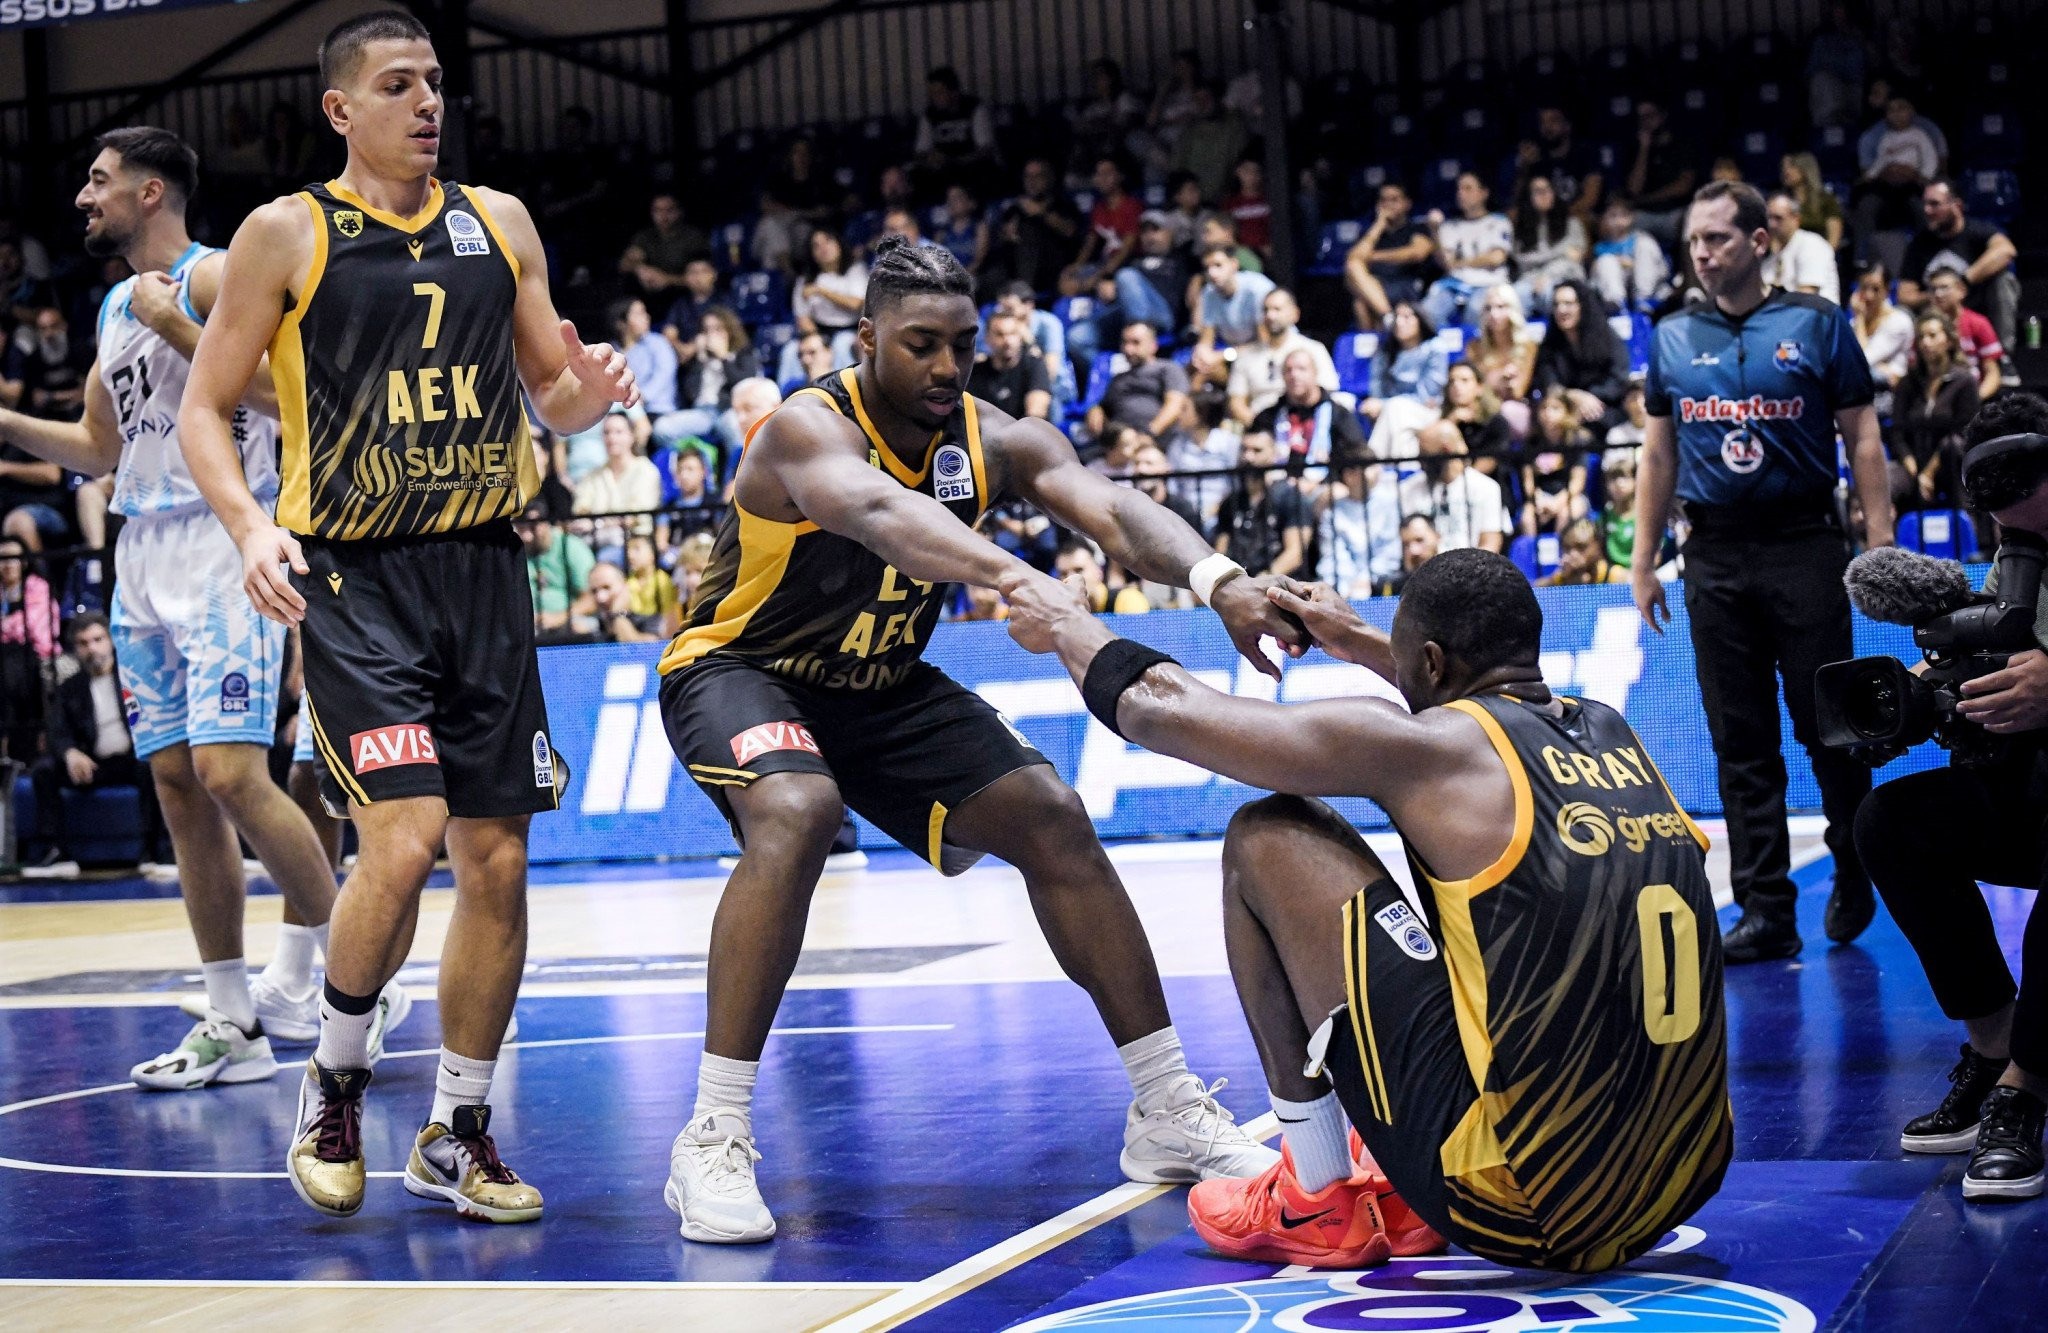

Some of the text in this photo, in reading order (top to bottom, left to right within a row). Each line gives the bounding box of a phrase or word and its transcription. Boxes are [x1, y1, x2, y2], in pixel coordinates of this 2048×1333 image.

[456, 243, 486, 253] GBL
[413, 282, 446, 349] 7
[112, 355, 153, 425] 21
[387, 365, 482, 425] AEK
[407, 475, 482, 492] Empowering
[936, 477, 971, 487] Stoiximan
[938, 484, 971, 499] GBL
[839, 603, 929, 658] AEK
[357, 728, 435, 769] AVIS
[740, 722, 820, 763] AVIS
[537, 772, 552, 784] GBL
[1542, 745, 1653, 790] GRAY
[1380, 904, 1409, 923] GBL
[1637, 884, 1700, 1045] 0
